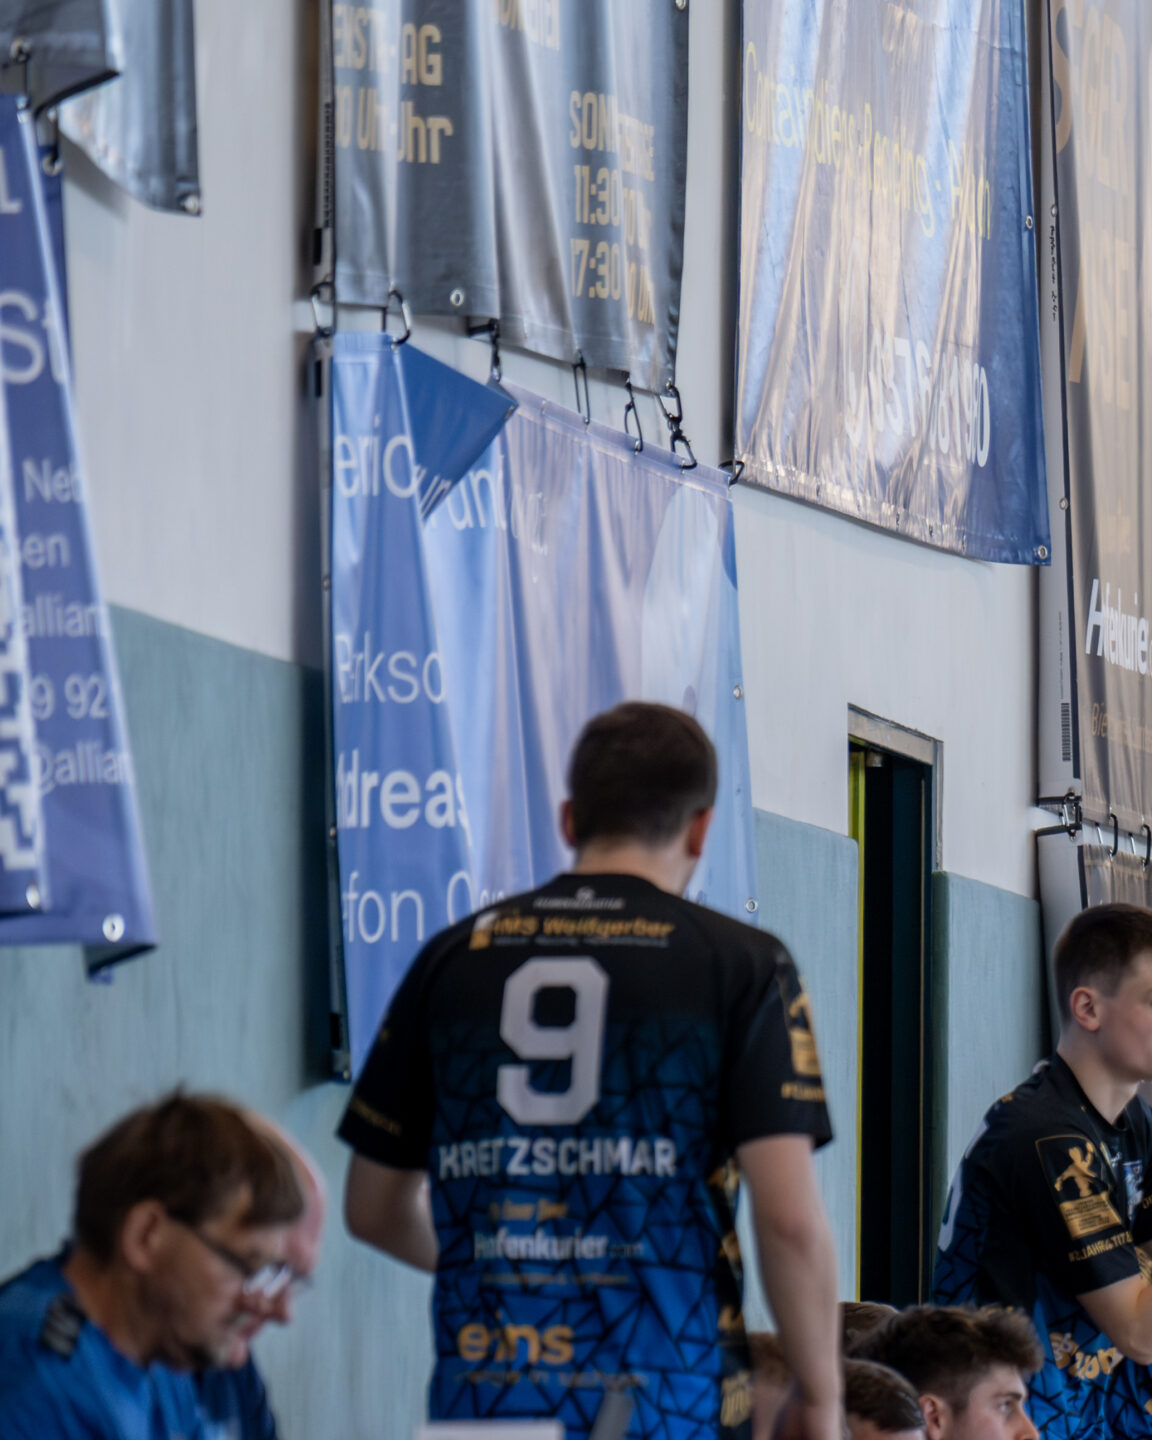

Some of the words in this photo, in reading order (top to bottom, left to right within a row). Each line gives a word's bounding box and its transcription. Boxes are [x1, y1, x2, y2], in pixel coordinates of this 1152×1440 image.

[574, 165, 621, 227] 11:30
[497, 956, 610, 1125] 9
[439, 1136, 677, 1181] KRETZSCHMAR
